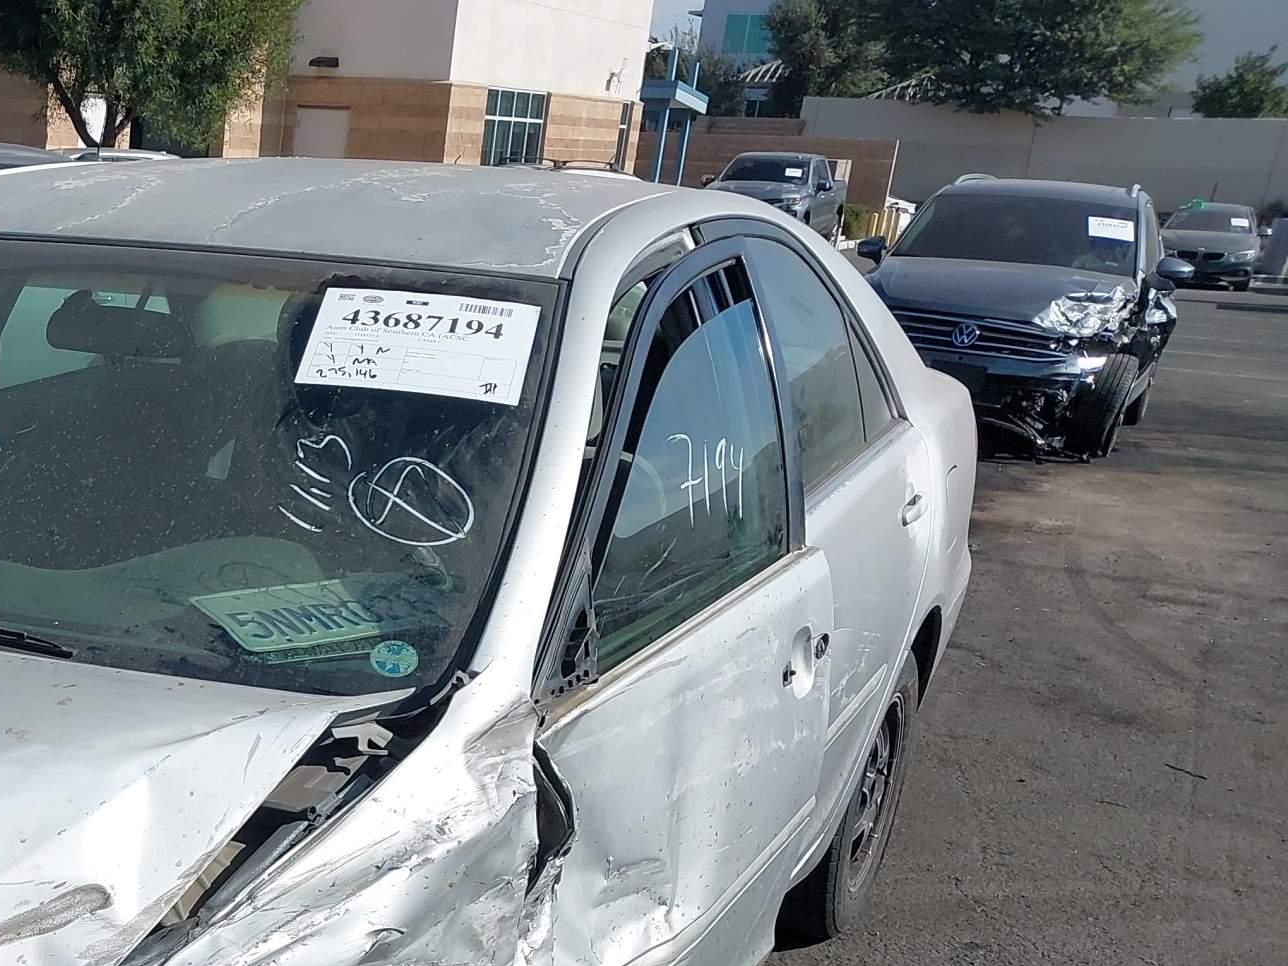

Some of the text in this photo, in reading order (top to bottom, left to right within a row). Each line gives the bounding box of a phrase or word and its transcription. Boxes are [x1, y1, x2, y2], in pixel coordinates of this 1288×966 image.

[342, 309, 503, 340] 43687194
[348, 325, 370, 333] Club
[383, 328, 419, 338] Southern
[665, 433, 744, 528] 7194
